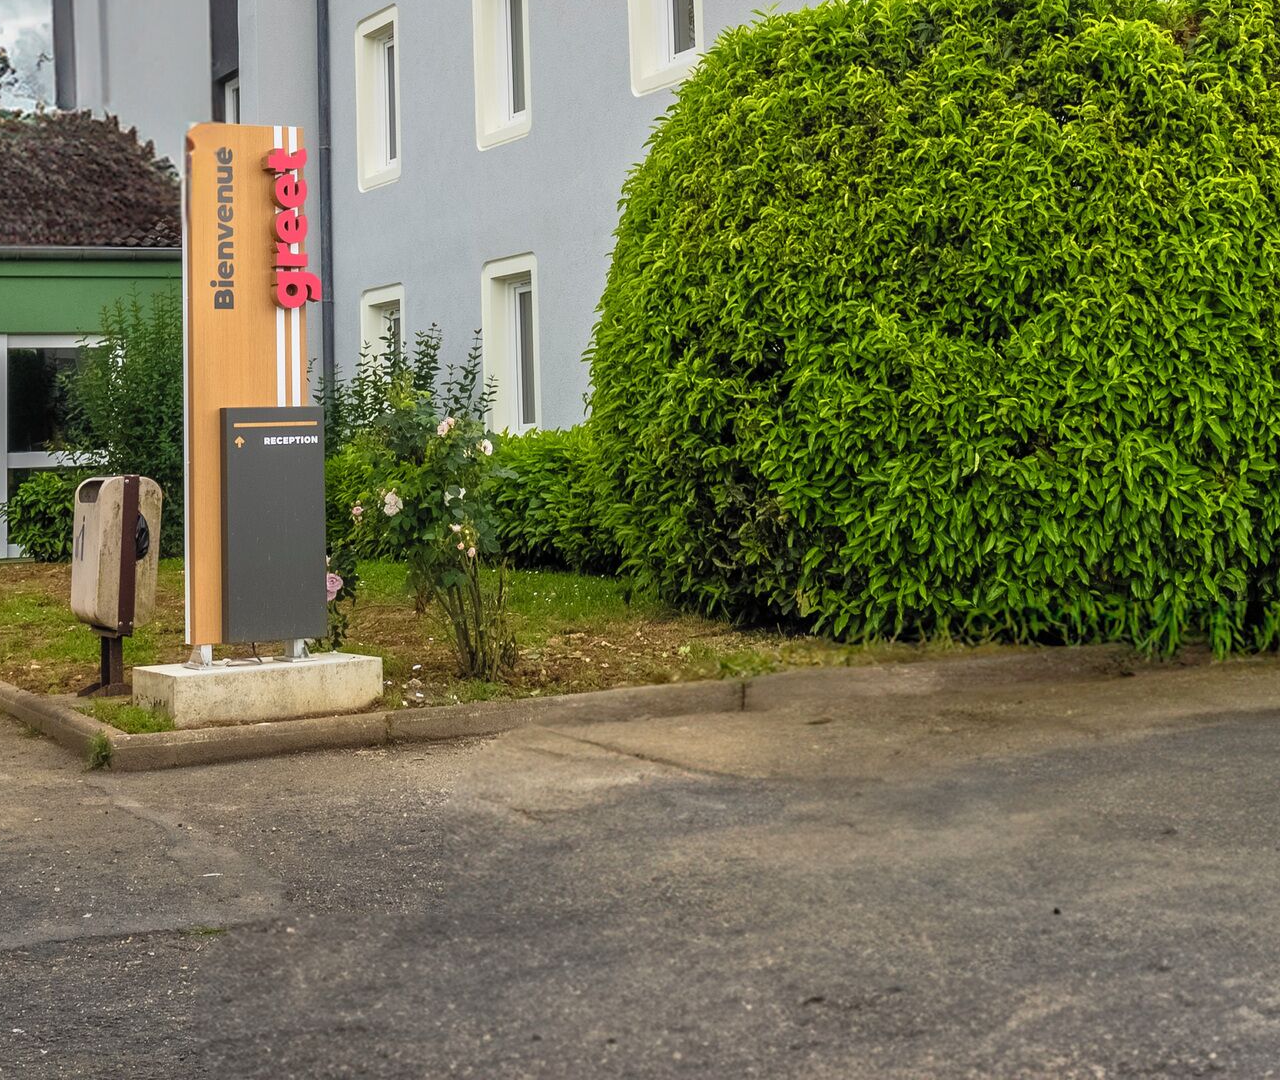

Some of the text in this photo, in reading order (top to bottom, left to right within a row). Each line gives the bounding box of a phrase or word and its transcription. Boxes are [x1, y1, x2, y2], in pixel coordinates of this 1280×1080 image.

[210, 146, 234, 310] Bienvenue
[265, 148, 322, 308] greet
[263, 435, 319, 445] RECEPTION
